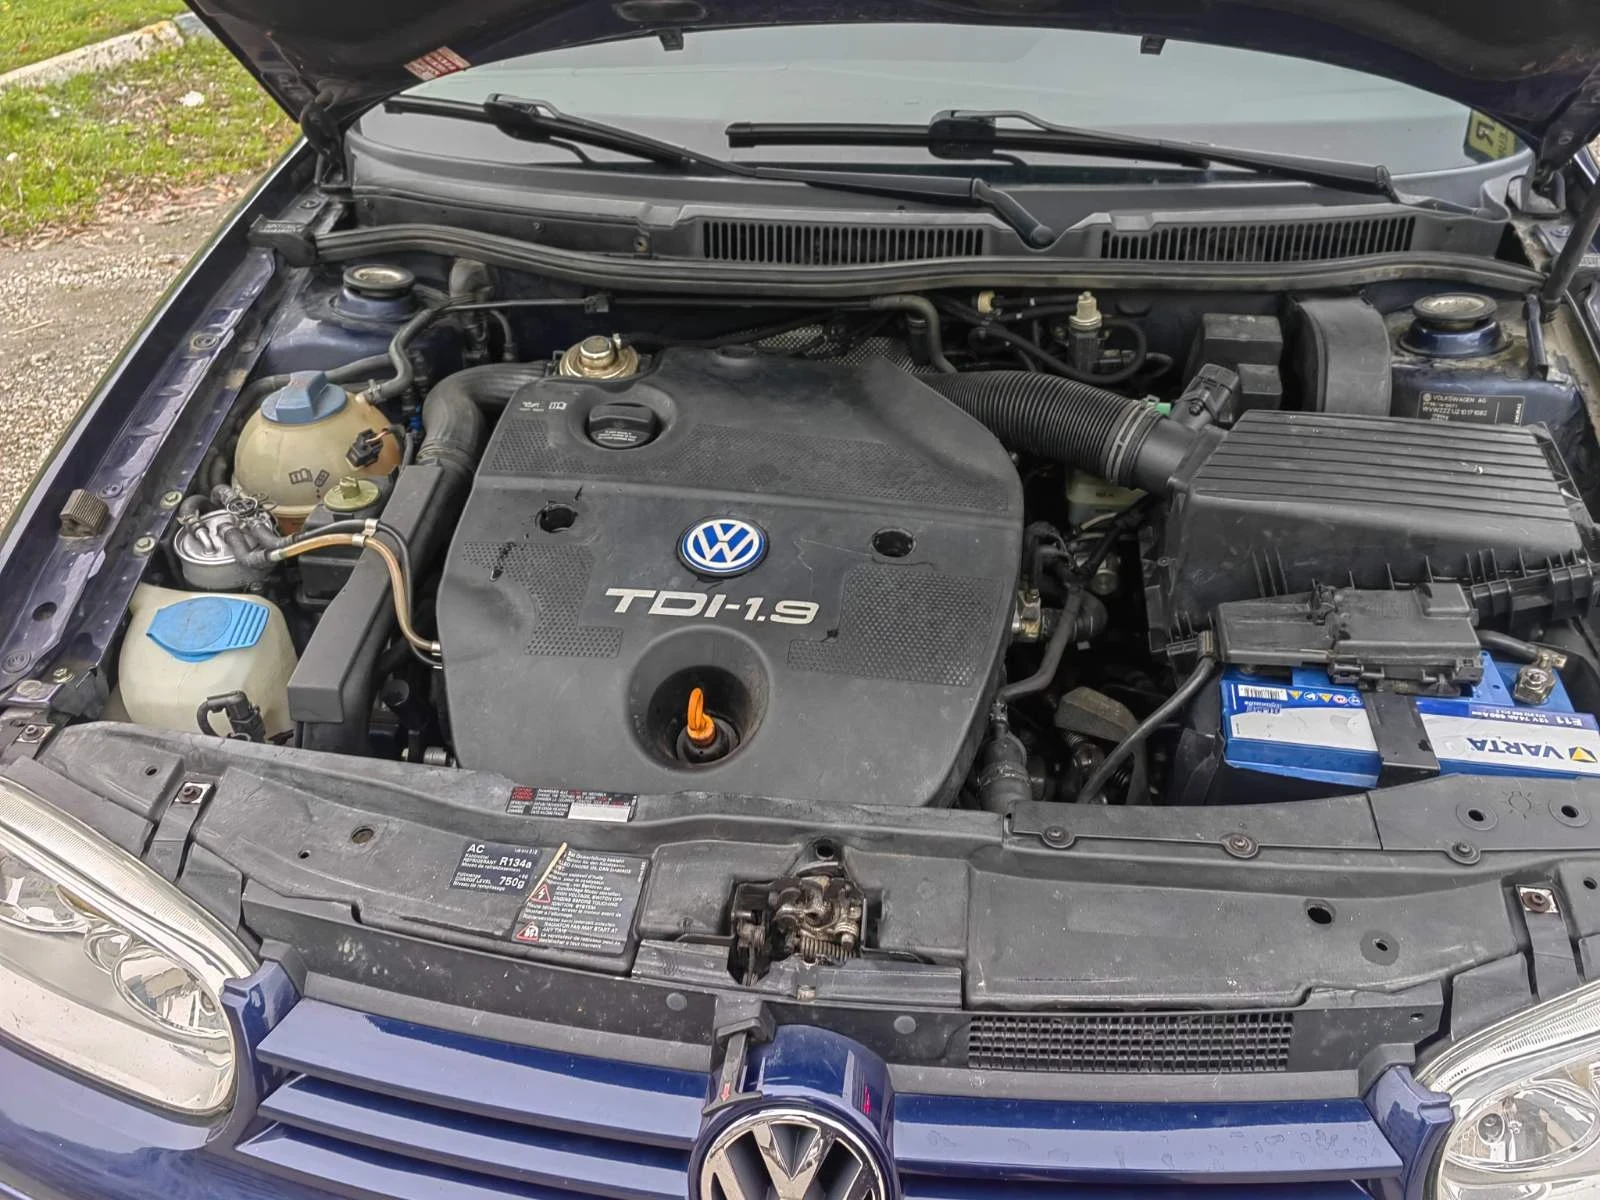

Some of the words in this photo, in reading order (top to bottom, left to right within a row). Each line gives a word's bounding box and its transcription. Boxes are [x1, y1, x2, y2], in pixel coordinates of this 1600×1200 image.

[605, 588, 820, 625] TDI-1.9
[1467, 737, 1565, 760] VARTA
[467, 844, 485, 854] AC
[500, 856, 532, 869] R134a
[499, 876, 526, 890] 750g
